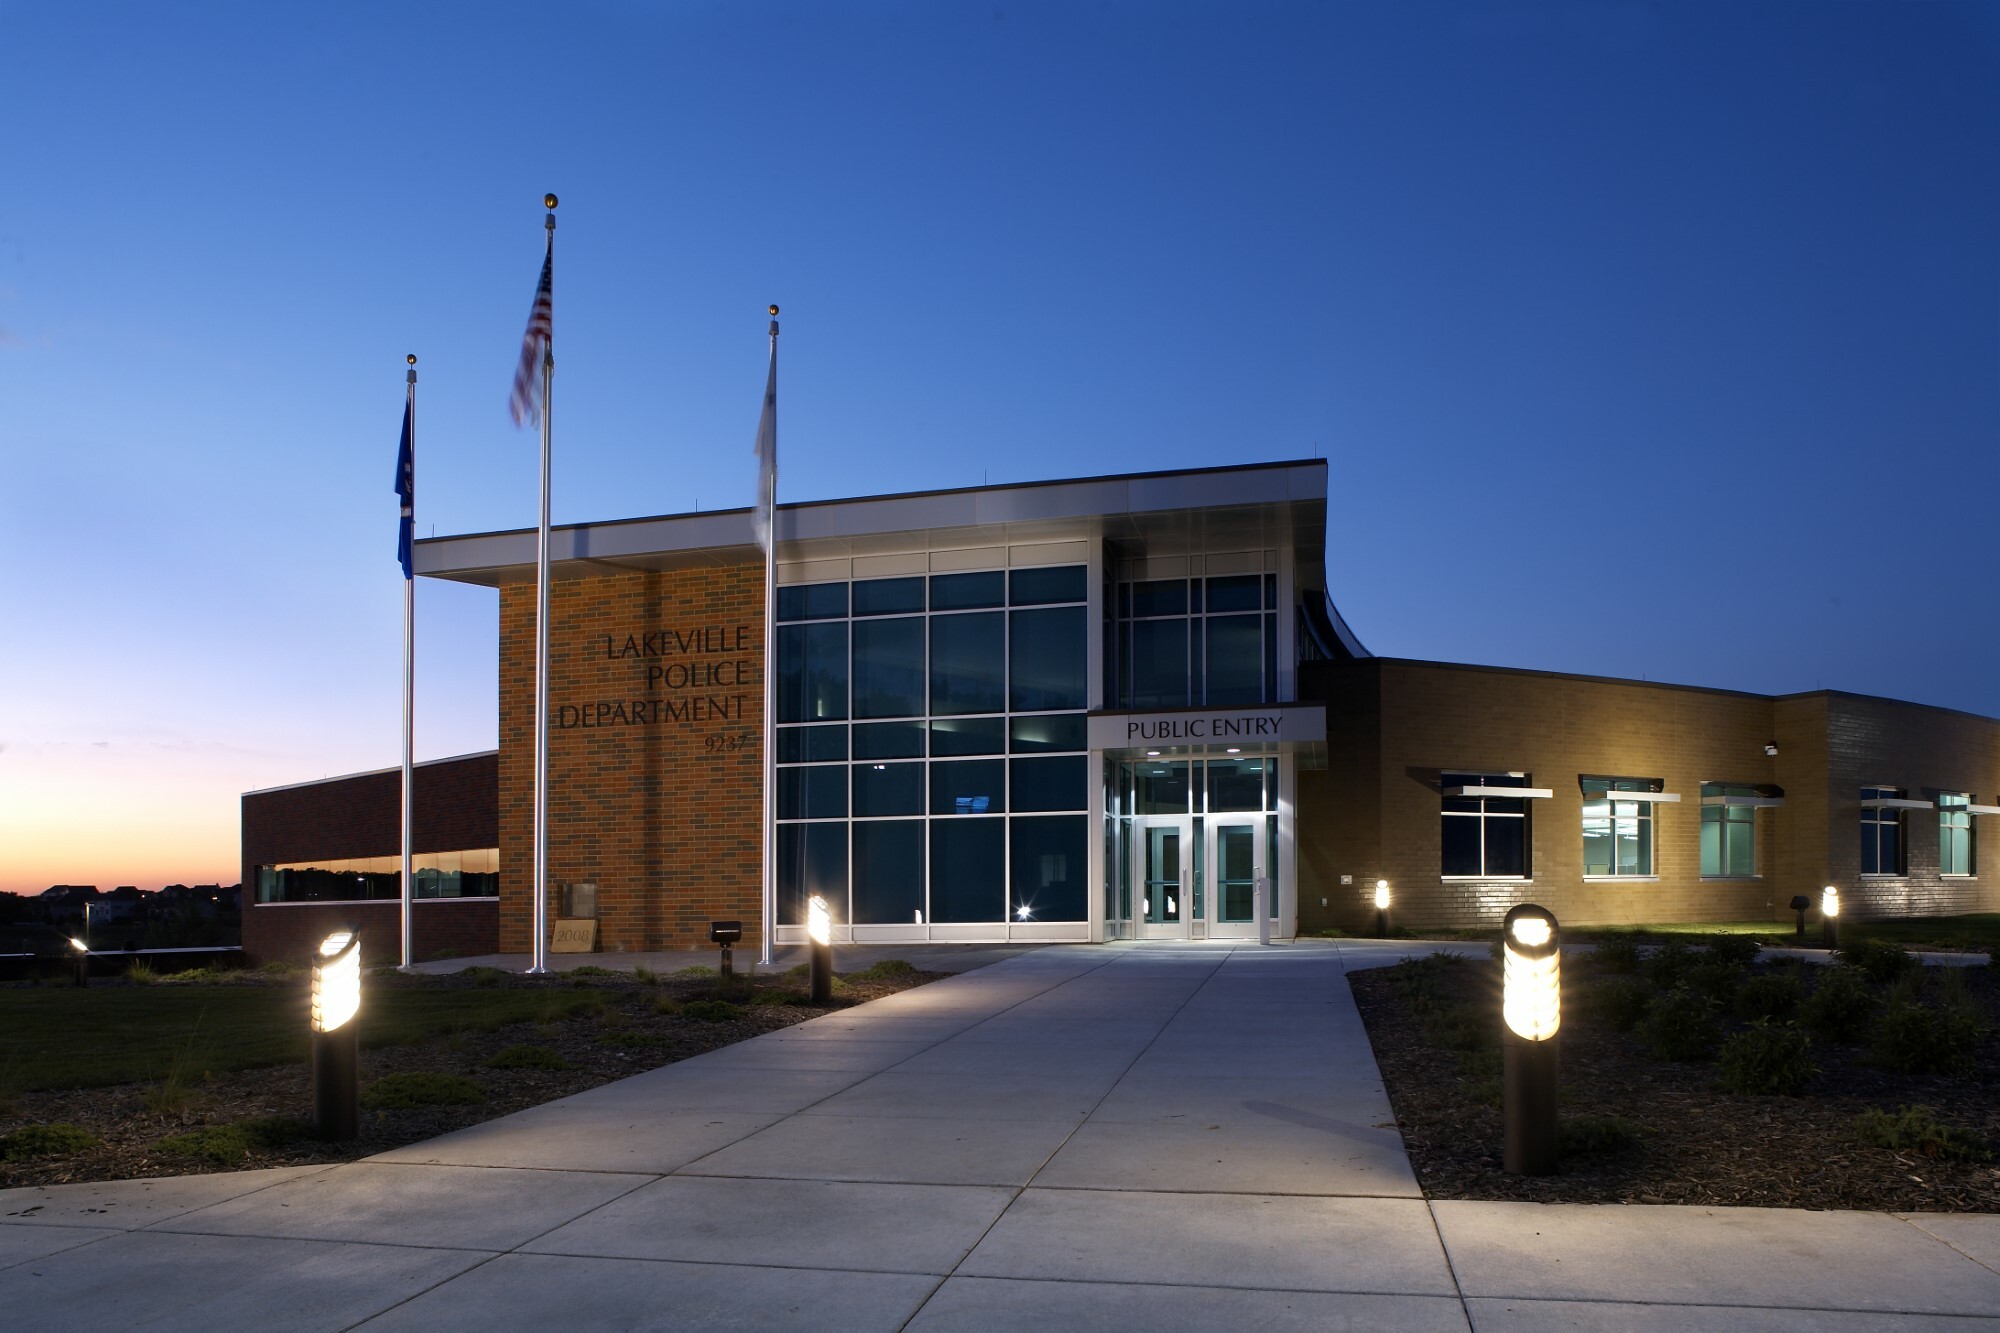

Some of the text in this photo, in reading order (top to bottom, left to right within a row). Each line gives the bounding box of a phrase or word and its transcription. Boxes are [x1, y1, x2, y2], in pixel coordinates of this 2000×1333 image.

[607, 626, 749, 660] LAKEVILLE
[648, 660, 749, 690] POLICE
[559, 695, 748, 729] DEPARTMENT
[1128, 716, 1283, 740] PUBLIC ENTRY
[704, 735, 748, 753] 9237
[557, 929, 590, 943] 2008
